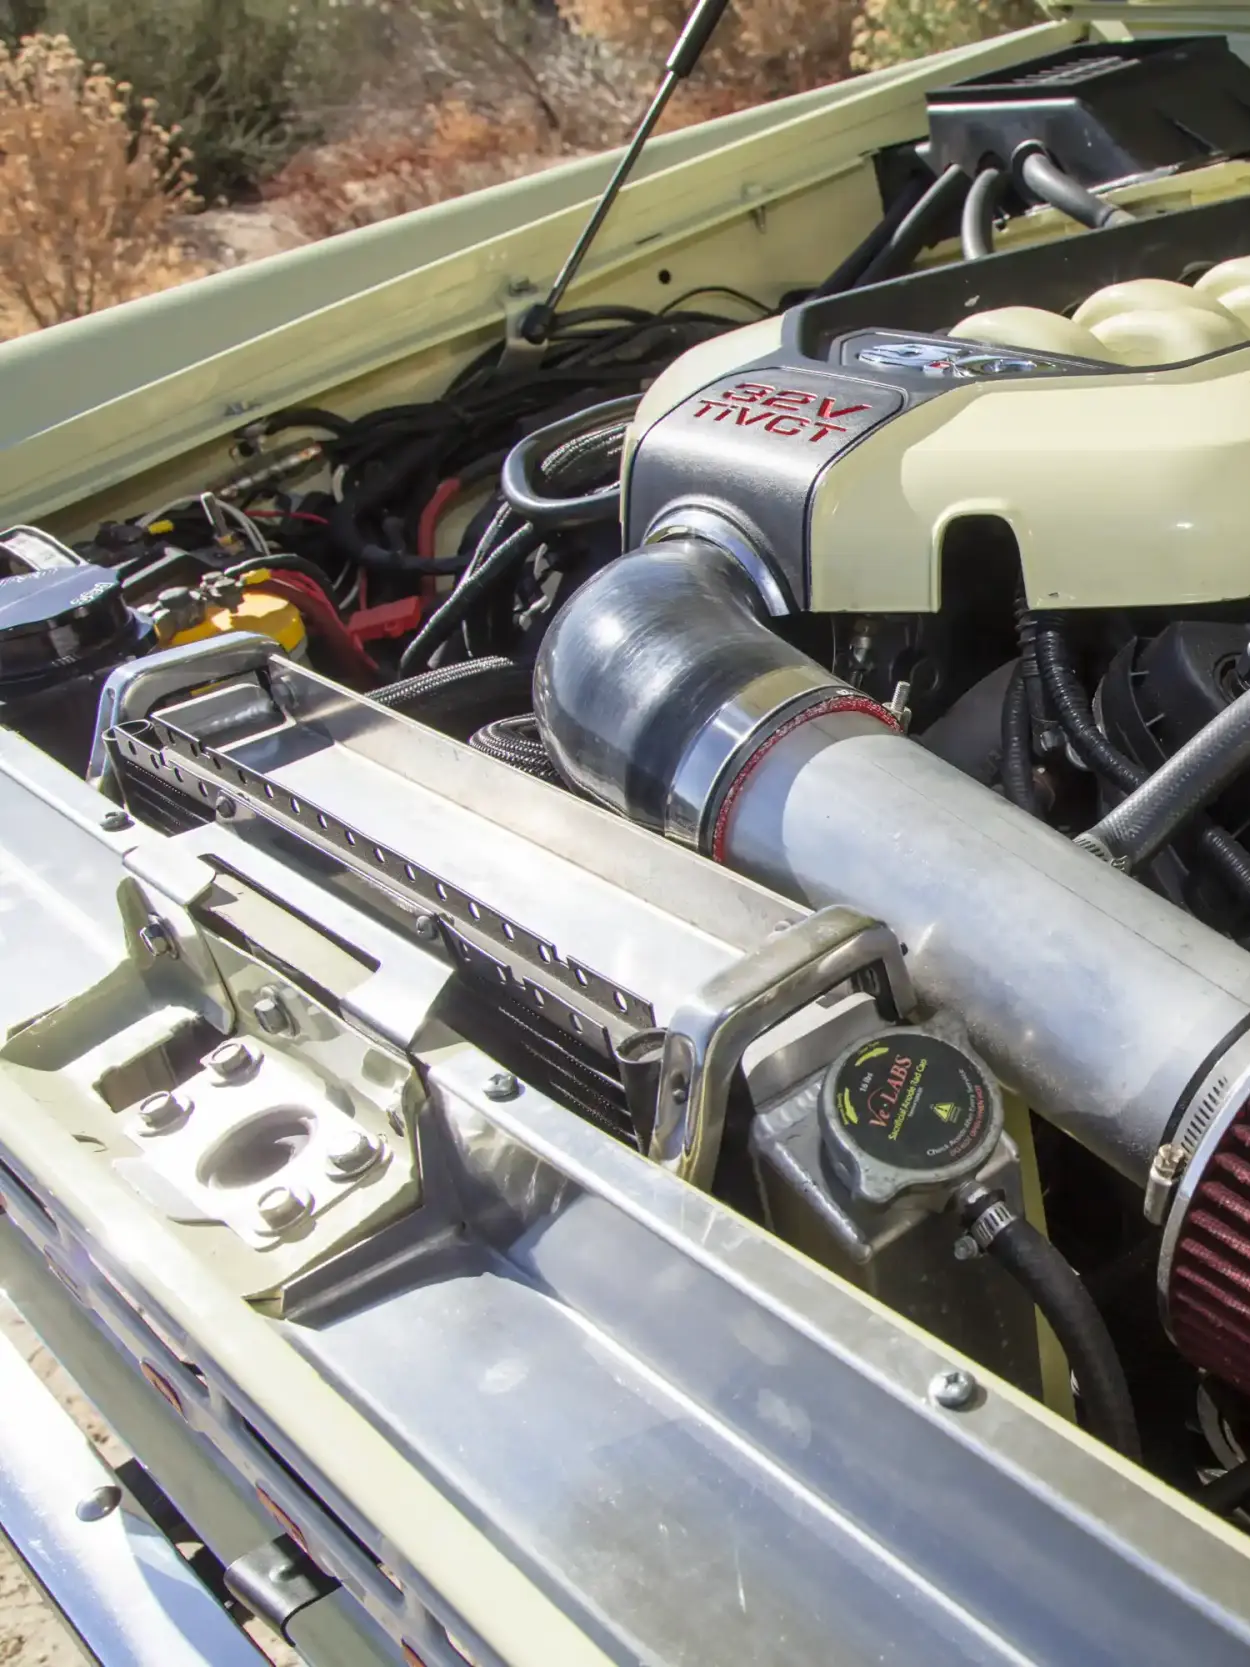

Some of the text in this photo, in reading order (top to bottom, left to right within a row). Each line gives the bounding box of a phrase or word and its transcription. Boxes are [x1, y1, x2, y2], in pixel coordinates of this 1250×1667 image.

[721, 383, 873, 419] 32V
[915, 1058, 928, 1073] Cap
[926, 1143, 950, 1156] Check
